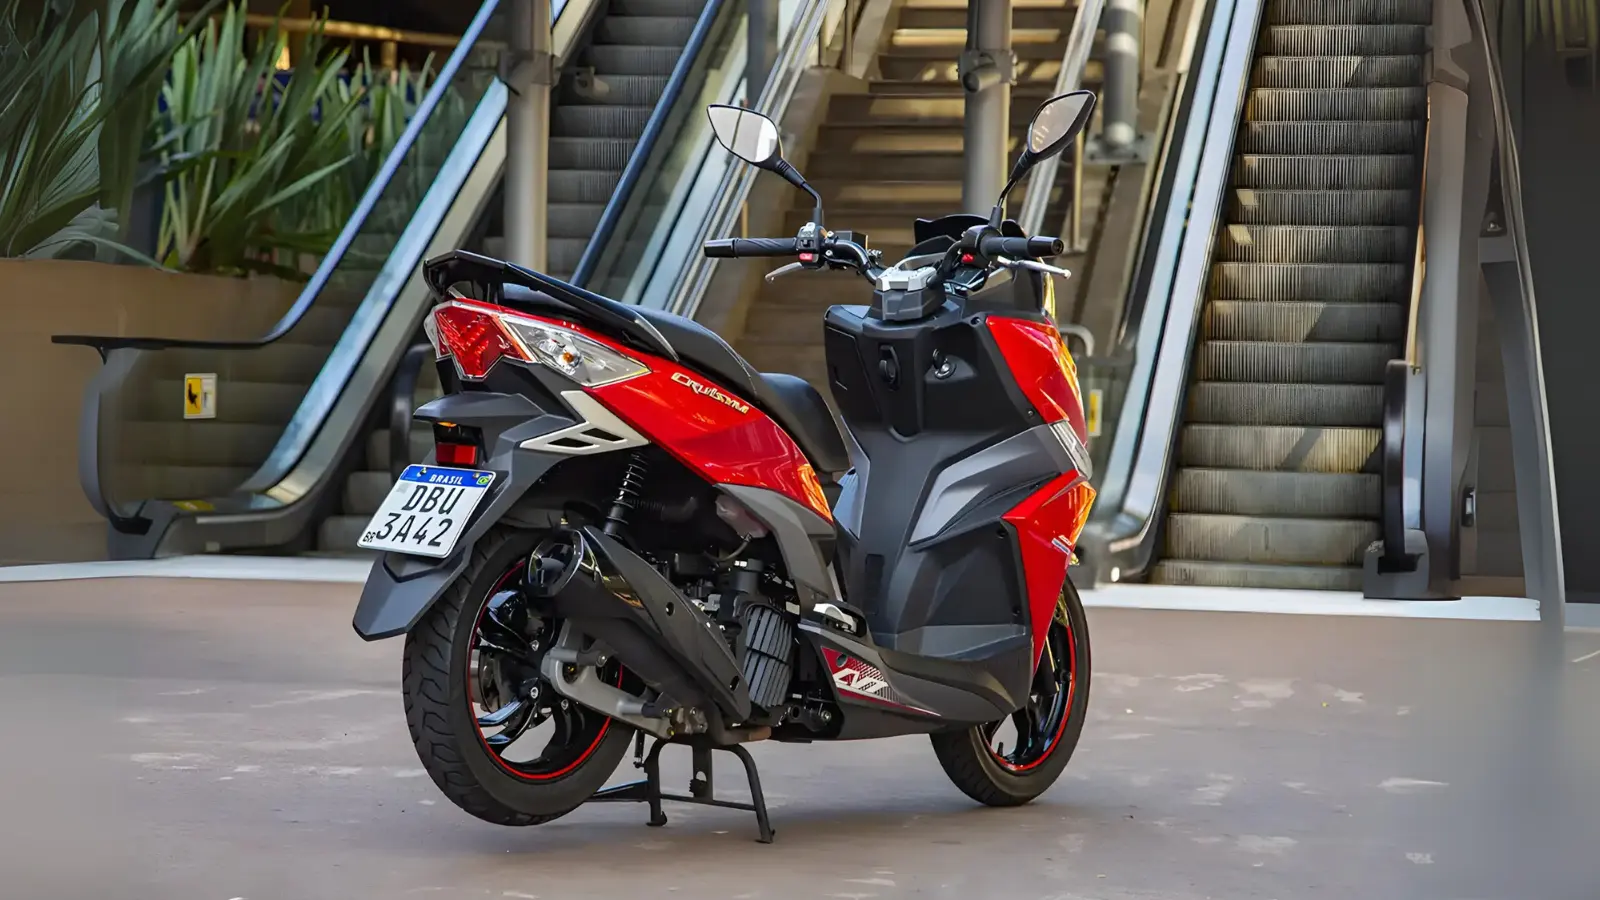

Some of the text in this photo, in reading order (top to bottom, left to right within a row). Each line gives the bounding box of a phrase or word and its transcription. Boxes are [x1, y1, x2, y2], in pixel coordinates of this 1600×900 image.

[429, 474, 464, 485] BRASIL
[401, 485, 466, 515] DBU
[376, 512, 453, 547] 3A42
